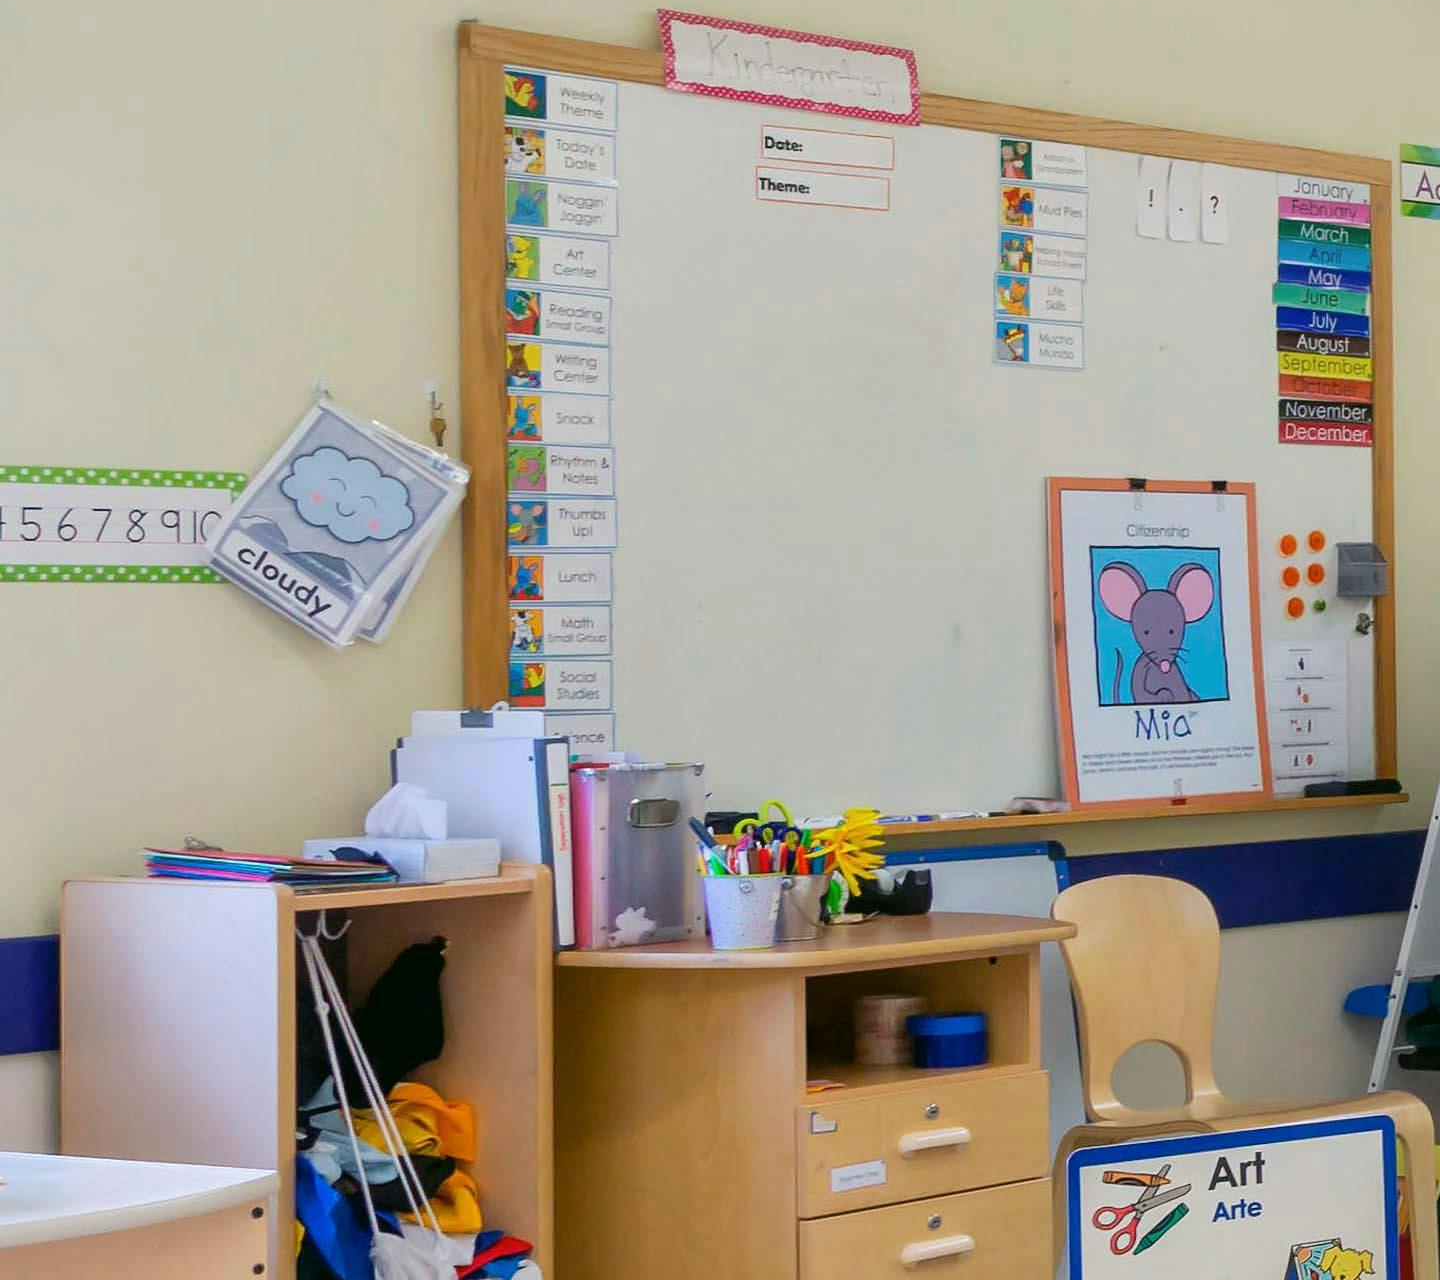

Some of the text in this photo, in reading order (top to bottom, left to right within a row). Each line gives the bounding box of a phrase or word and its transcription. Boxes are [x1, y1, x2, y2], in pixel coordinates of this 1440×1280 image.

[560, 103, 604, 120] Theme
[764, 136, 803, 152] Date:
[564, 156, 597, 171] Date
[759, 177, 810, 194] Theme:
[1293, 178, 1353, 202] January
[1292, 200, 1357, 220] February
[1300, 224, 1349, 242] March
[566, 249, 583, 261] Art
[1309, 246, 1342, 266] April
[552, 263, 597, 278] Center
[1308, 269, 1341, 290] May
[1302, 291, 1338, 308] June
[550, 304, 602, 321] Reading
[1308, 313, 1337, 332] July
[1297, 335, 1350, 357] August
[555, 354, 598, 370] Writing
[1282, 355, 1368, 380] September
[553, 370, 599, 384] Center
[556, 412, 595, 425] Snack
[1286, 402, 1367, 420] November
[1285, 424, 1367, 442] December
[563, 472, 598, 485] Notes
[20, 507, 43, 542] 5
[57, 508, 78, 542] 6
[92, 508, 112, 542] 7
[126, 509, 147, 543] 8
[160, 510, 180, 543] 9
[1127, 524, 1190, 540] Citizenship
[237, 545, 333, 618] cloudy
[559, 571, 597, 584] Lunch
[559, 671, 597, 683] Social
[556, 687, 600, 702] Studies
[1135, 709, 1192, 741] Mia
[1208, 1151, 1266, 1192] Art
[1211, 1198, 1263, 1223] Arte
